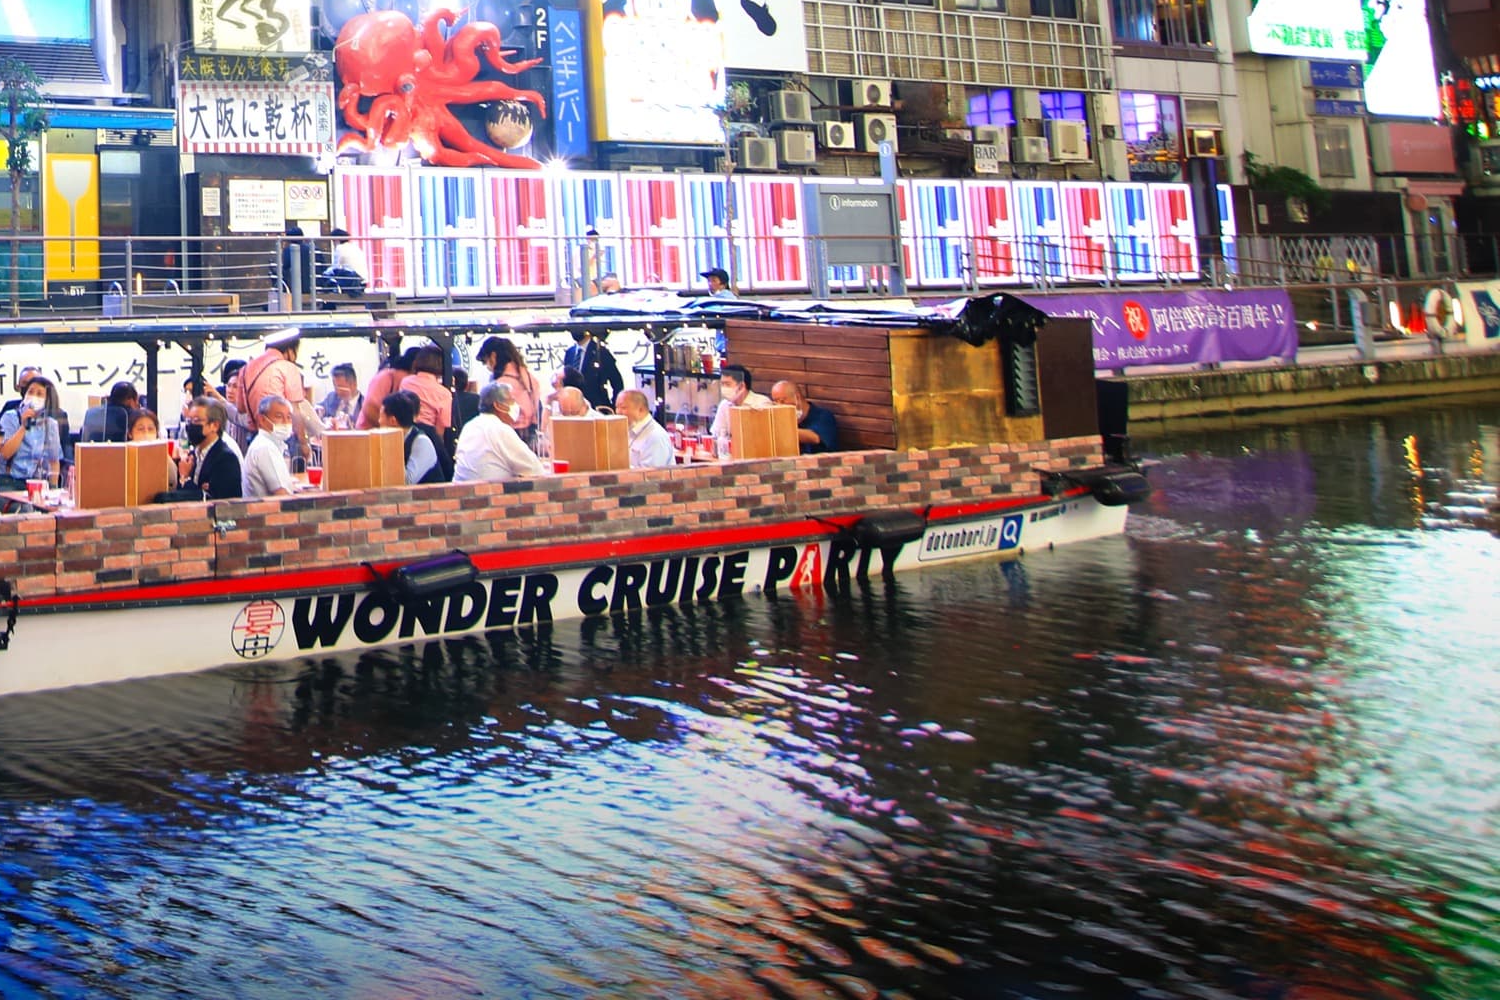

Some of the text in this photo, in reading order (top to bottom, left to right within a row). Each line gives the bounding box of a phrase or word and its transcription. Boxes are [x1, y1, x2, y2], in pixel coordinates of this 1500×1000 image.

[535, 7, 548, 49] 2F
[189, 93, 312, 141] 大阪に乾杯
[975, 145, 997, 160] BAR
[1125, 306, 1145, 332] 祝
[926, 524, 997, 552] dotonbori.jp
[292, 572, 558, 652] WONDER
[577, 548, 750, 617] CRUISE
